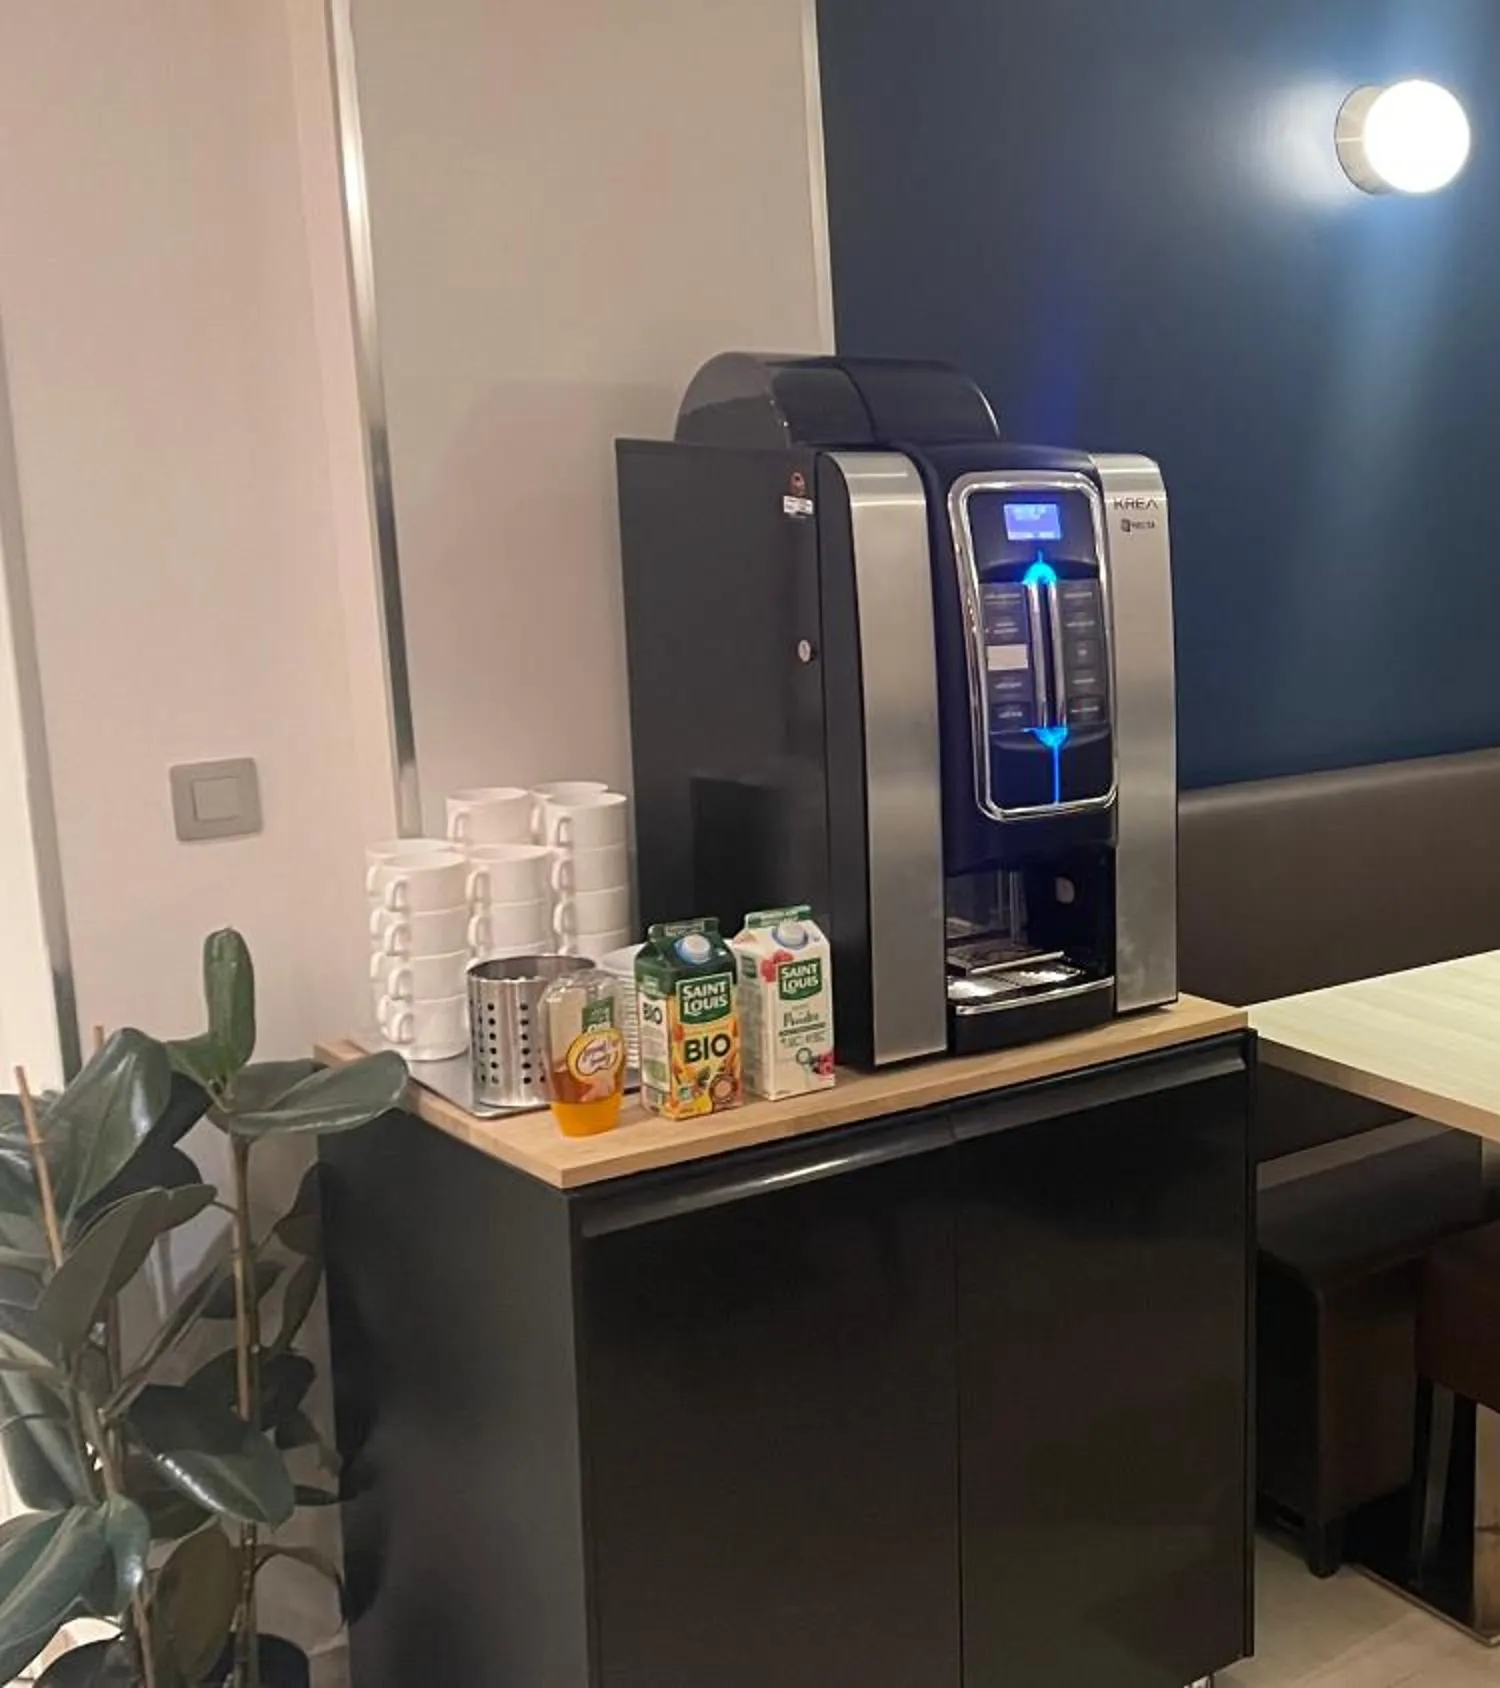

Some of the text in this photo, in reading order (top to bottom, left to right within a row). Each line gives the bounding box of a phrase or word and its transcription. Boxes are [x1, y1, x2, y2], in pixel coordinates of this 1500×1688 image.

[781, 963, 818, 979] SAINT
[682, 981, 727, 998] SAINT
[782, 976, 819, 994] LOUIS
[683, 996, 728, 1016] LOUIS
[684, 1033, 731, 1065] BIO
